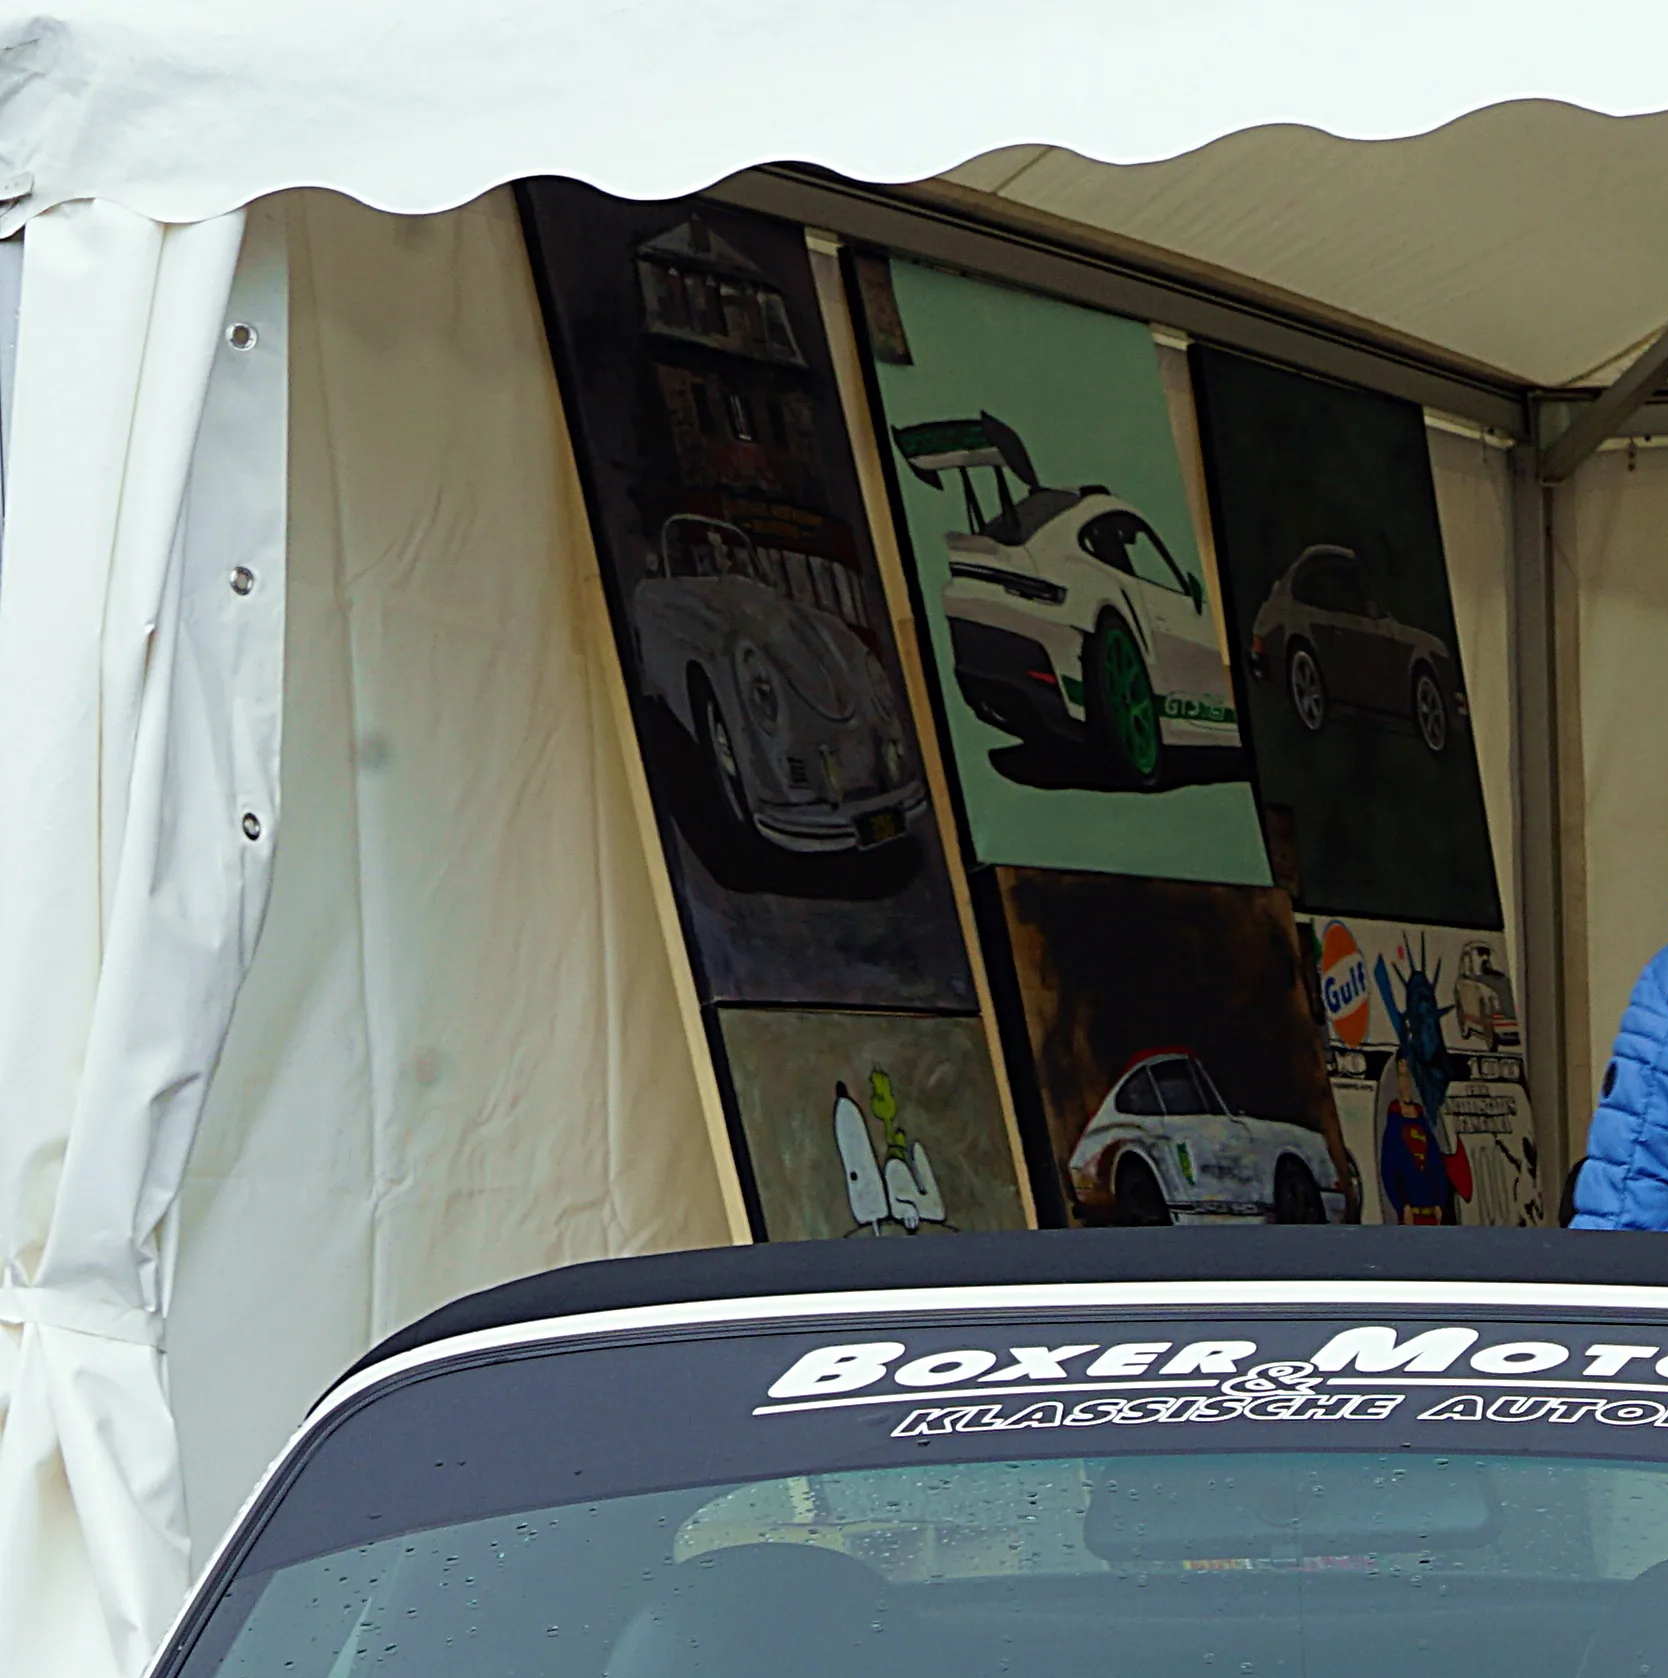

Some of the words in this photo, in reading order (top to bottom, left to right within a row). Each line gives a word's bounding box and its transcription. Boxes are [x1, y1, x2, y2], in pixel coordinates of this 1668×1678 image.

[1325, 962, 1365, 1012] Gulf
[768, 1340, 1258, 1400] BOXER
[890, 1393, 1404, 1438] KLASSISCHE
